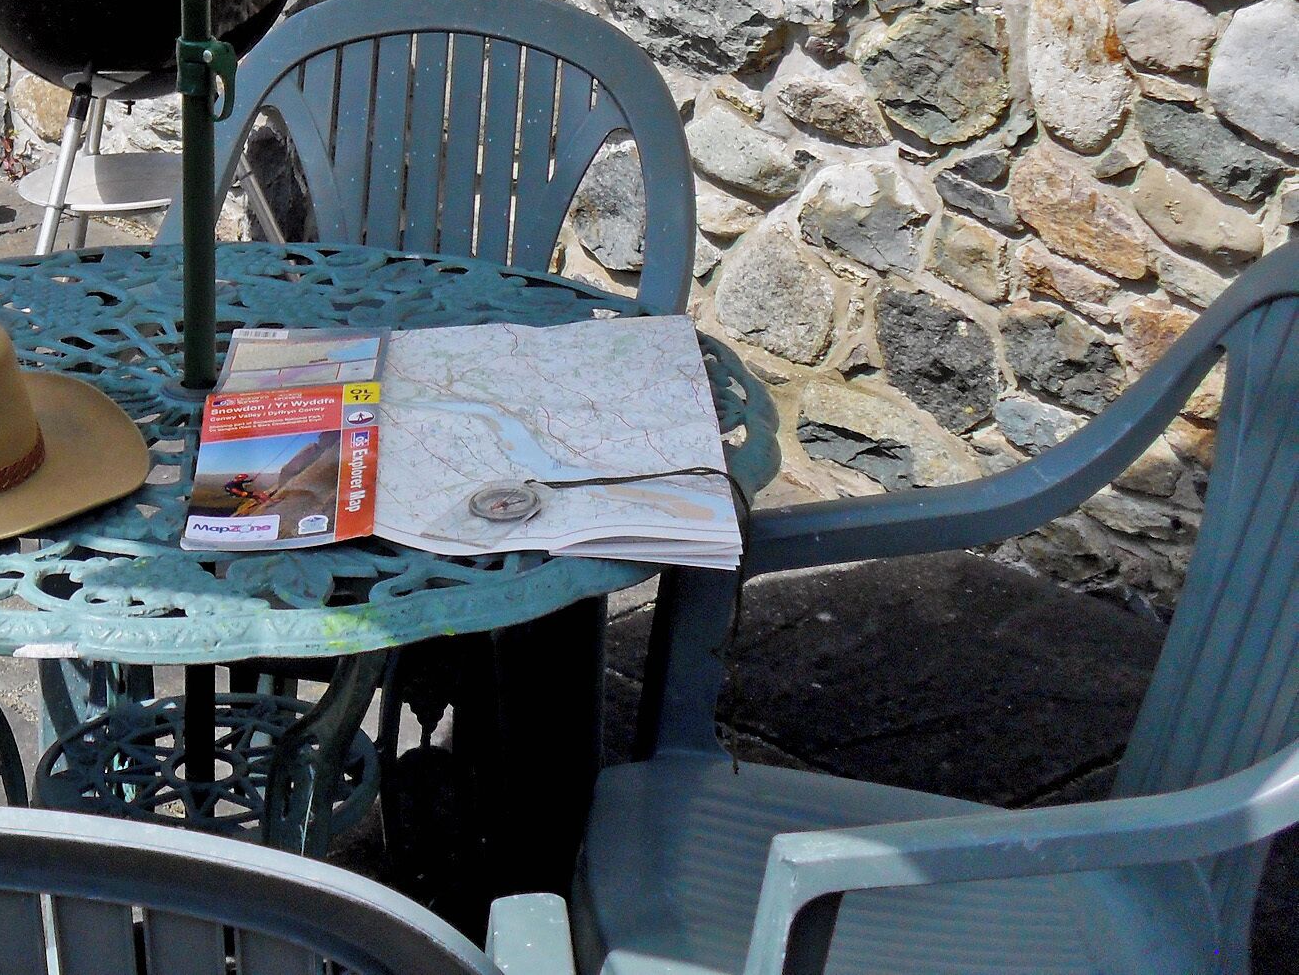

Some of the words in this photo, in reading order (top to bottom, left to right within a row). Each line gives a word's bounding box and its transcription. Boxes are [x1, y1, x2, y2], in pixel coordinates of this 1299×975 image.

[211, 405, 264, 415] Snowdon
[275, 401, 288, 409] Yr
[290, 397, 335, 408] Wyddfa
[238, 412, 261, 420] Valley
[348, 448, 368, 489] Explorer
[345, 490, 366, 512] Map
